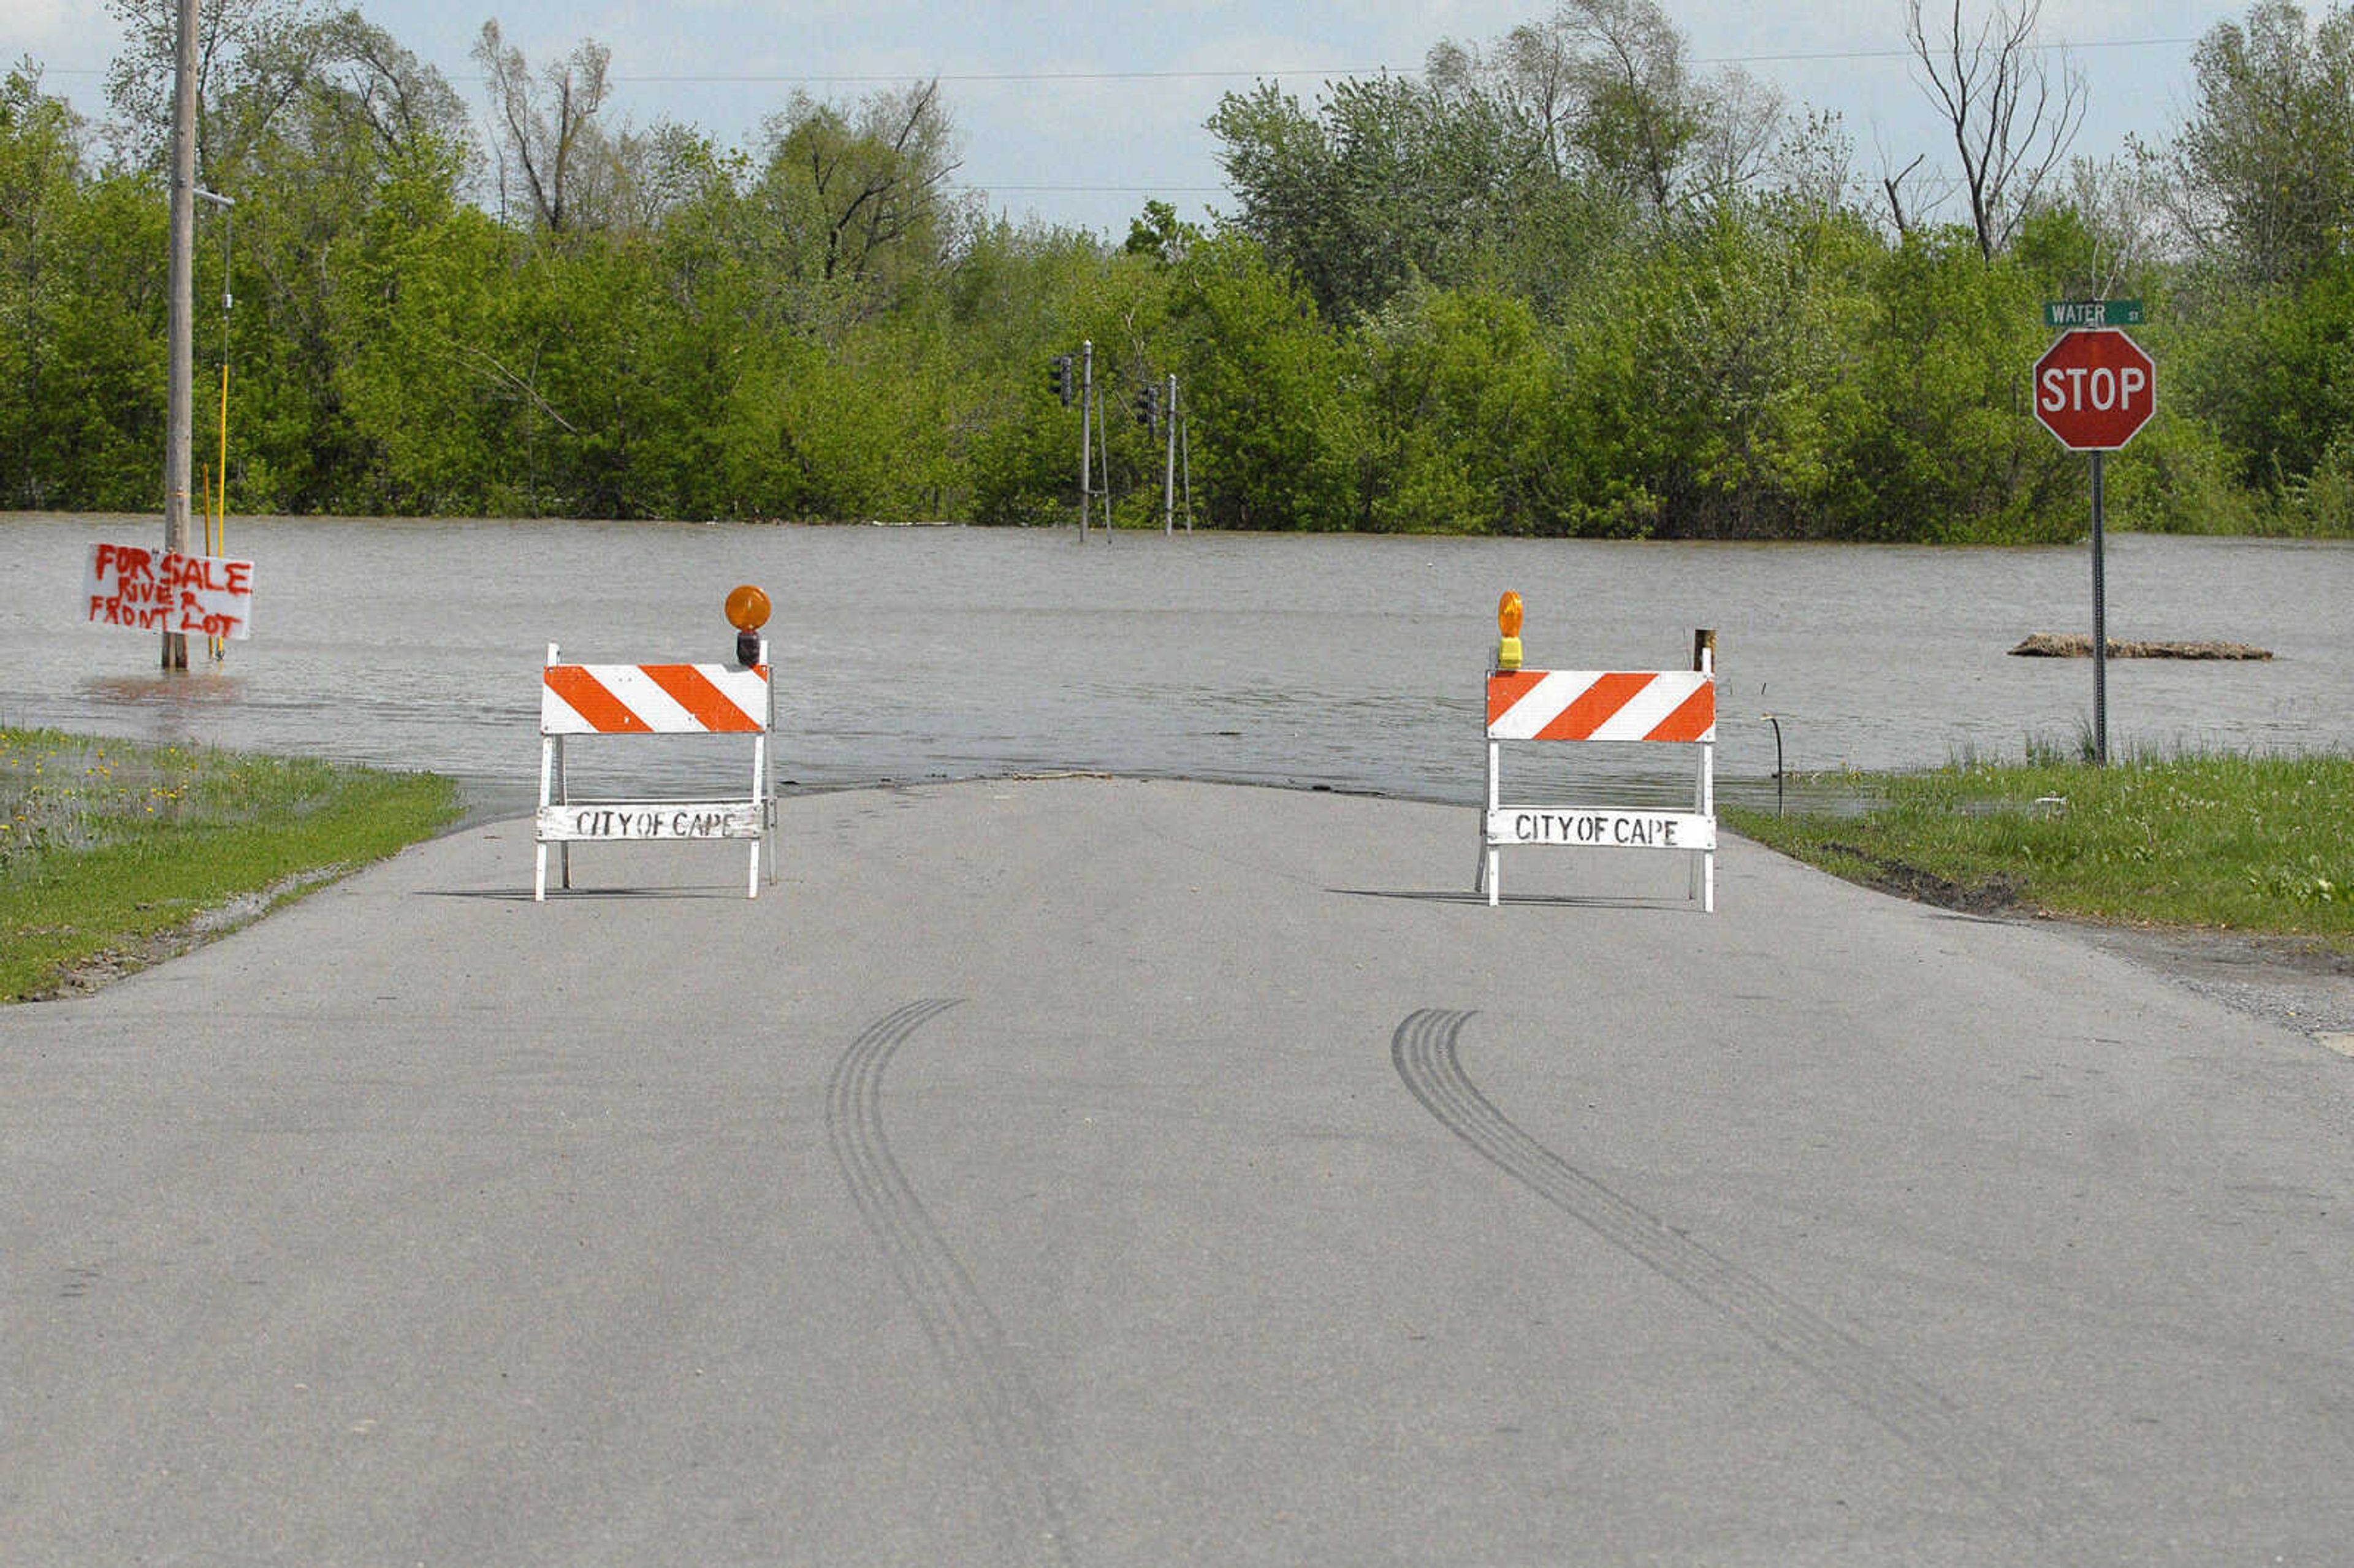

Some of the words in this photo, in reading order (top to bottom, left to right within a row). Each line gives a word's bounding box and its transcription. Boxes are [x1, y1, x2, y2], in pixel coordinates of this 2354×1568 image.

[2052, 305, 2105, 324] WATER
[2041, 367, 2145, 411] STOP
[95, 544, 154, 580] FOR
[160, 553, 252, 596] SALE
[90, 595, 174, 631] FRONT
[180, 612, 242, 638] LOT
[576, 811, 632, 837] CITY
[637, 813, 664, 836] OF
[672, 812, 736, 837] CAPE
[1515, 814, 1573, 841] CITY
[1577, 816, 1609, 843] OF
[1614, 818, 1678, 846] CAPE
